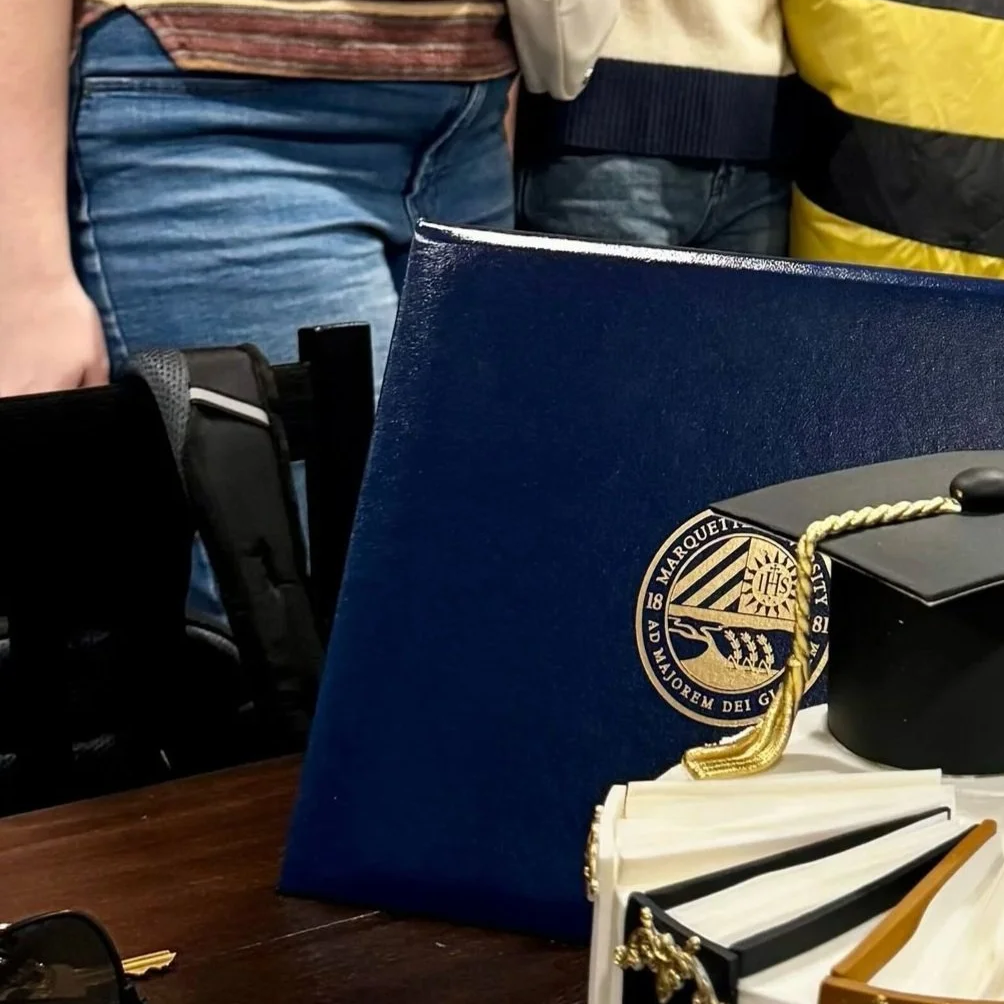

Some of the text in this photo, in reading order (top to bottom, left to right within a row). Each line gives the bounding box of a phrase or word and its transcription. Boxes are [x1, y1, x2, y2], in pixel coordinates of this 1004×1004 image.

[646, 592, 664, 611] 18
[811, 615, 830, 634] 81
[647, 619, 752, 713] AD MAJOREM DEI
